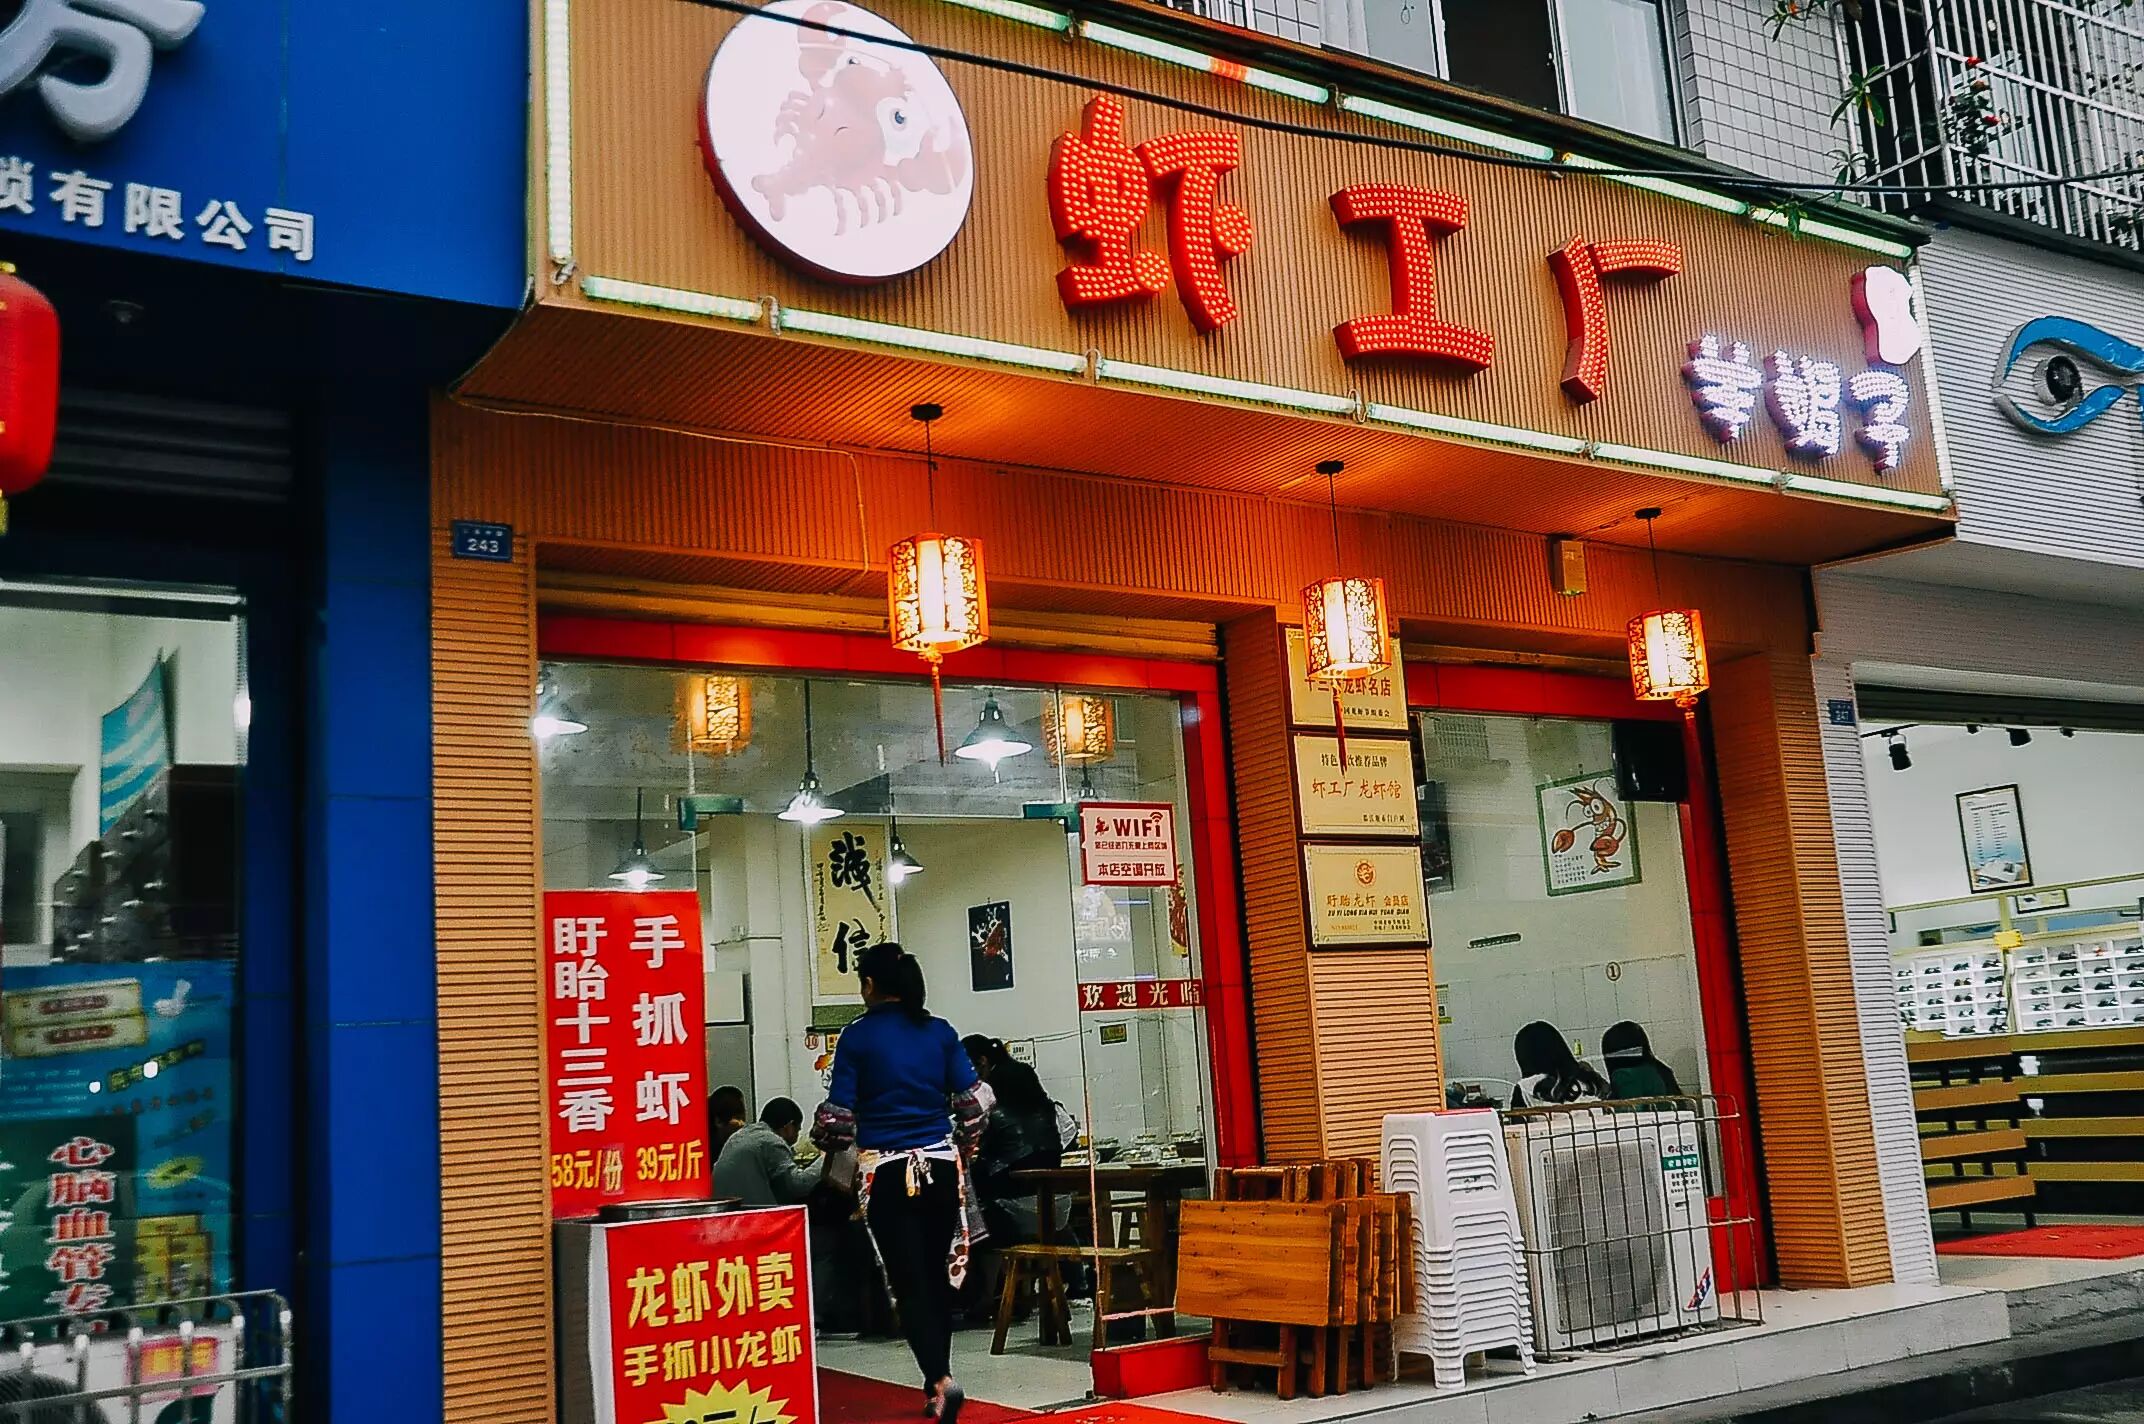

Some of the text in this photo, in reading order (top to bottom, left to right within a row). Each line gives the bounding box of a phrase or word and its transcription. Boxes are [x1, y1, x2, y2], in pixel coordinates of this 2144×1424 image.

[1049, 95, 1682, 402] 虾工厂
[467, 538, 499, 553] 243
[1321, 753, 1388, 768] 特色饮推荐品牌
[1312, 778, 1402, 799] 虾工厂 龙虾馆
[1098, 863, 1166, 877] 本店空调开放
[1082, 981, 1200, 1009] 欢迎光临
[553, 917, 614, 1132] 盱眙十三香
[629, 915, 690, 1125] 手抓虾
[551, 1150, 624, 1192] 58元/份
[636, 1139, 703, 1183] 39元/斤
[627, 1252, 794, 1329] 龙虾外卖
[624, 1324, 802, 1387] 手抓小龙虾
